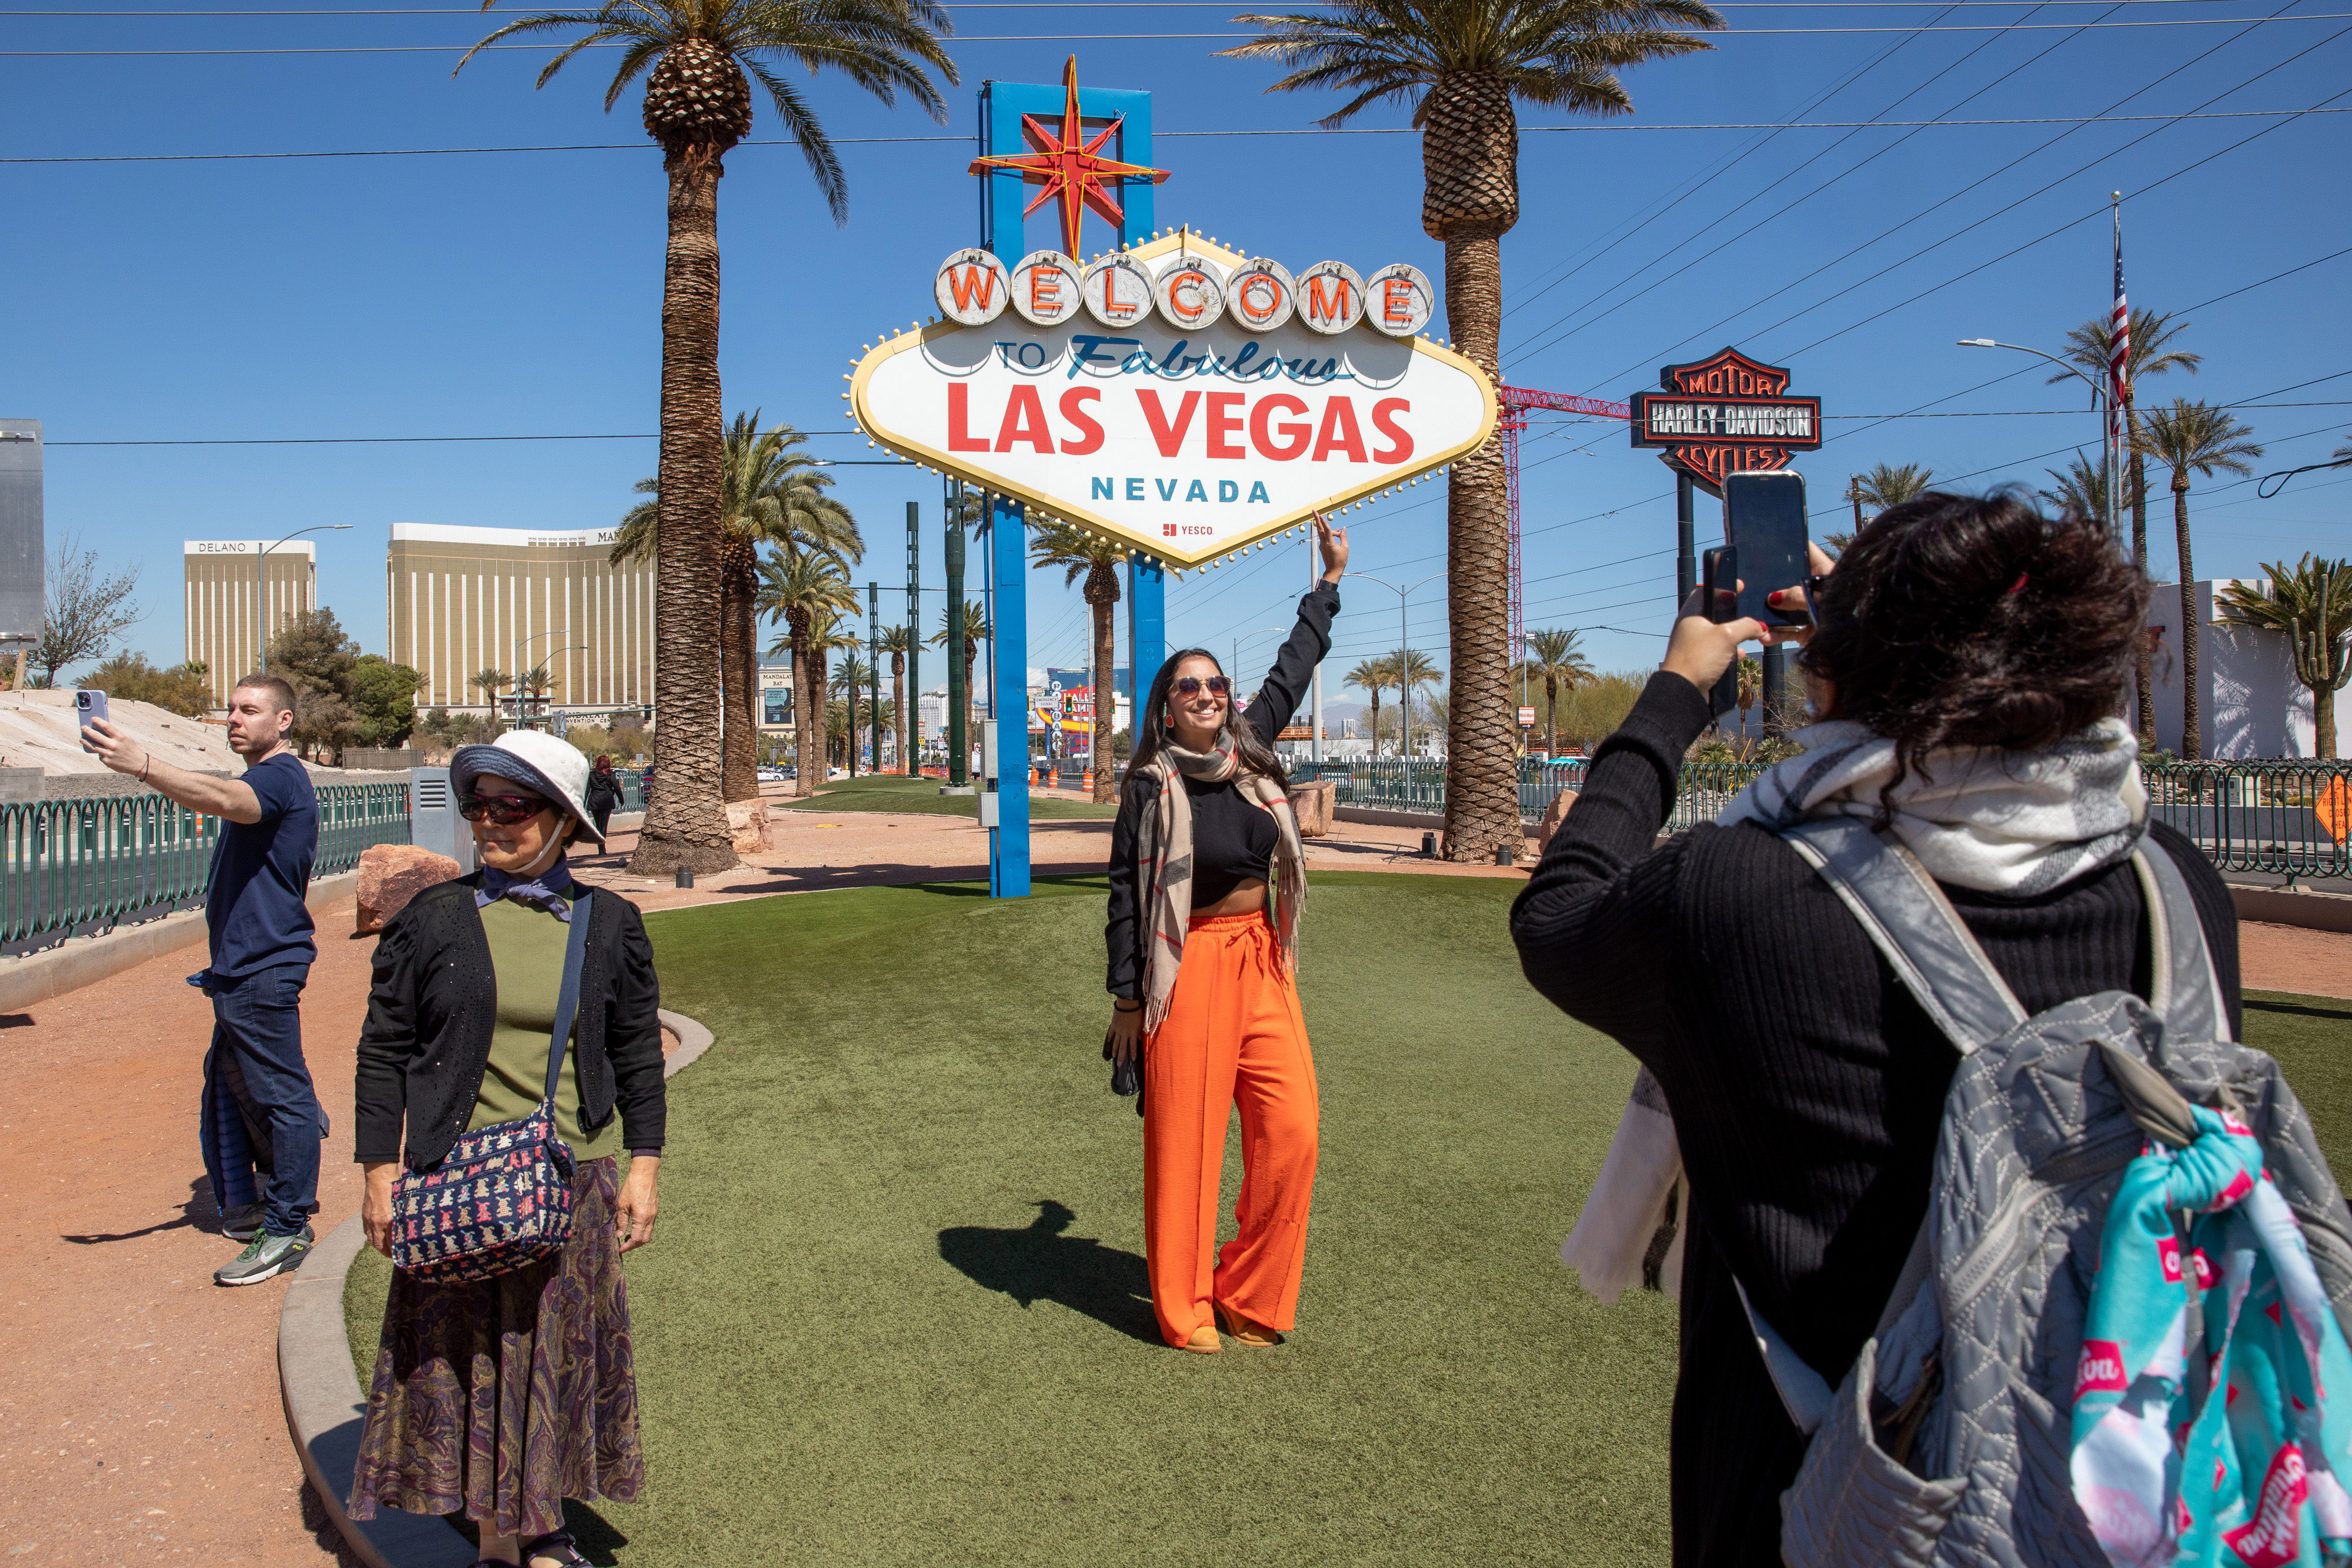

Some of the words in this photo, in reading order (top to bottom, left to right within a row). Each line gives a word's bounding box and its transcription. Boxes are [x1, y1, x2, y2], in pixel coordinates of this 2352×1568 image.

[947, 265, 1414, 322] WELCOME
[994, 342, 1046, 369] TO
[1067, 334, 1357, 381] Fabulous
[1689, 359, 1773, 395] MOTOR
[948, 382, 1105, 456] LAS
[1135, 389, 1414, 464] VEGAS
[1652, 403, 1812, 436] HARLEY-DAVIDSON
[1689, 444, 1774, 478] CYCLES
[1092, 477, 1270, 503] NEVADA
[1181, 526, 1213, 535] YESCO
[199, 543, 246, 552] DELANO
[2328, 808, 2350, 818] COSD
